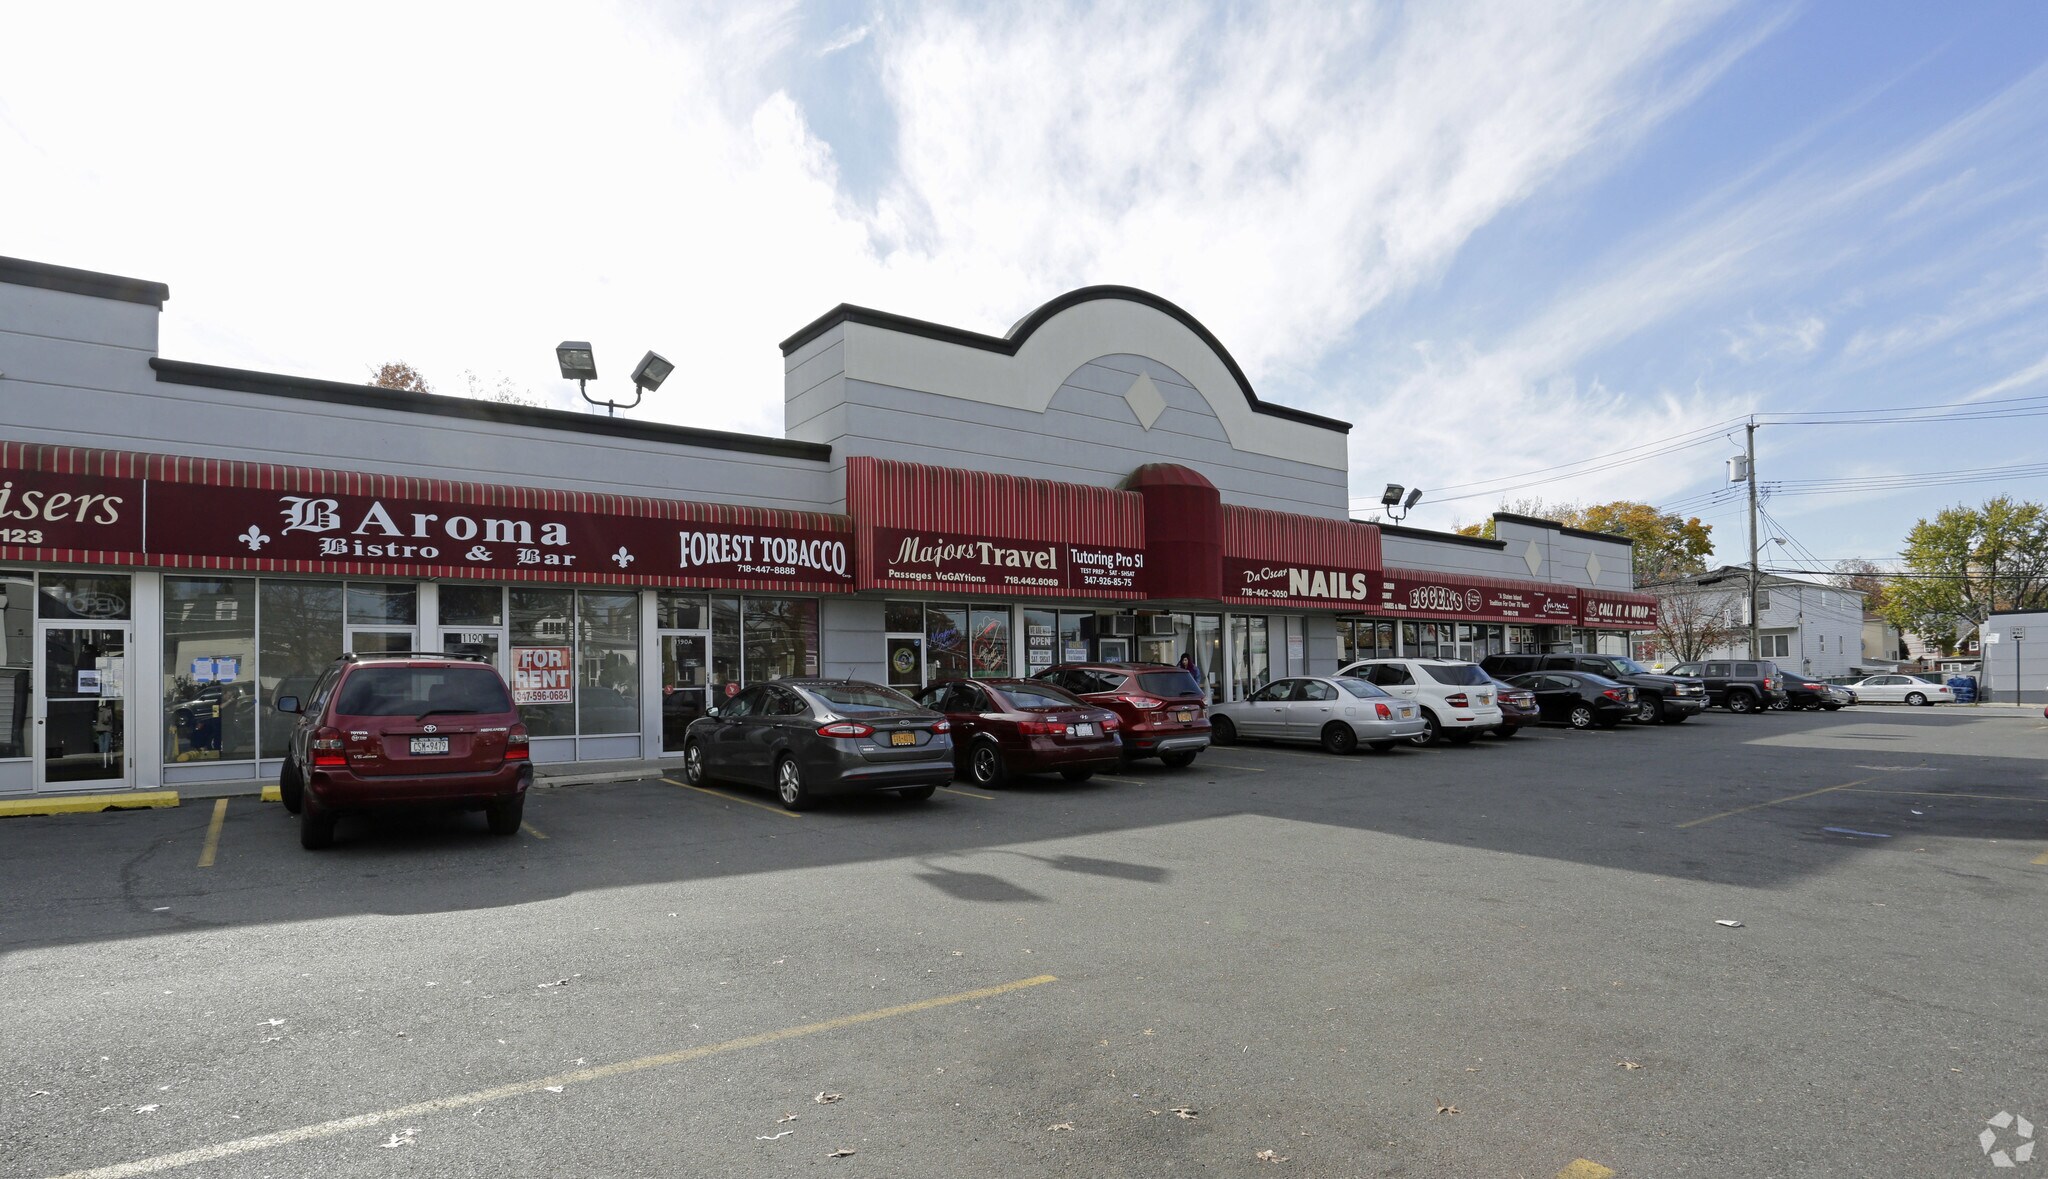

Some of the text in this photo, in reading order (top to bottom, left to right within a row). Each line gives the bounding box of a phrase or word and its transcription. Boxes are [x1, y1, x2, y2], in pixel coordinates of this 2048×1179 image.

[319, 538, 576, 566] Bistro & Bar
[679, 531, 846, 575] FOREST TOBACCO
[888, 536, 1058, 570] Majors Travel
[1070, 548, 1113, 569] Tutoring
[1115, 553, 1133, 567] Pro
[737, 564, 796, 575] 718-447-8888
[888, 568, 1059, 587] Passages VaGAYtions 718.442.6069
[1080, 567, 1092, 575] TEST
[1092, 568, 1105, 576] PREP
[1084, 576, 1132, 587] 347-926-85-75
[1243, 567, 1367, 601] Da Oscar NAILS
[1241, 587, 1288, 599] 718-442-3050
[1598, 603, 1613, 617] CALL
[1615, 604, 1622, 617] IT
[1624, 604, 1629, 618] A
[1631, 605, 1649, 619] WRAP
[1030, 636, 1051, 646] OPEN
[521, 649, 562, 668] FOR
[515, 669, 569, 688] RENT
